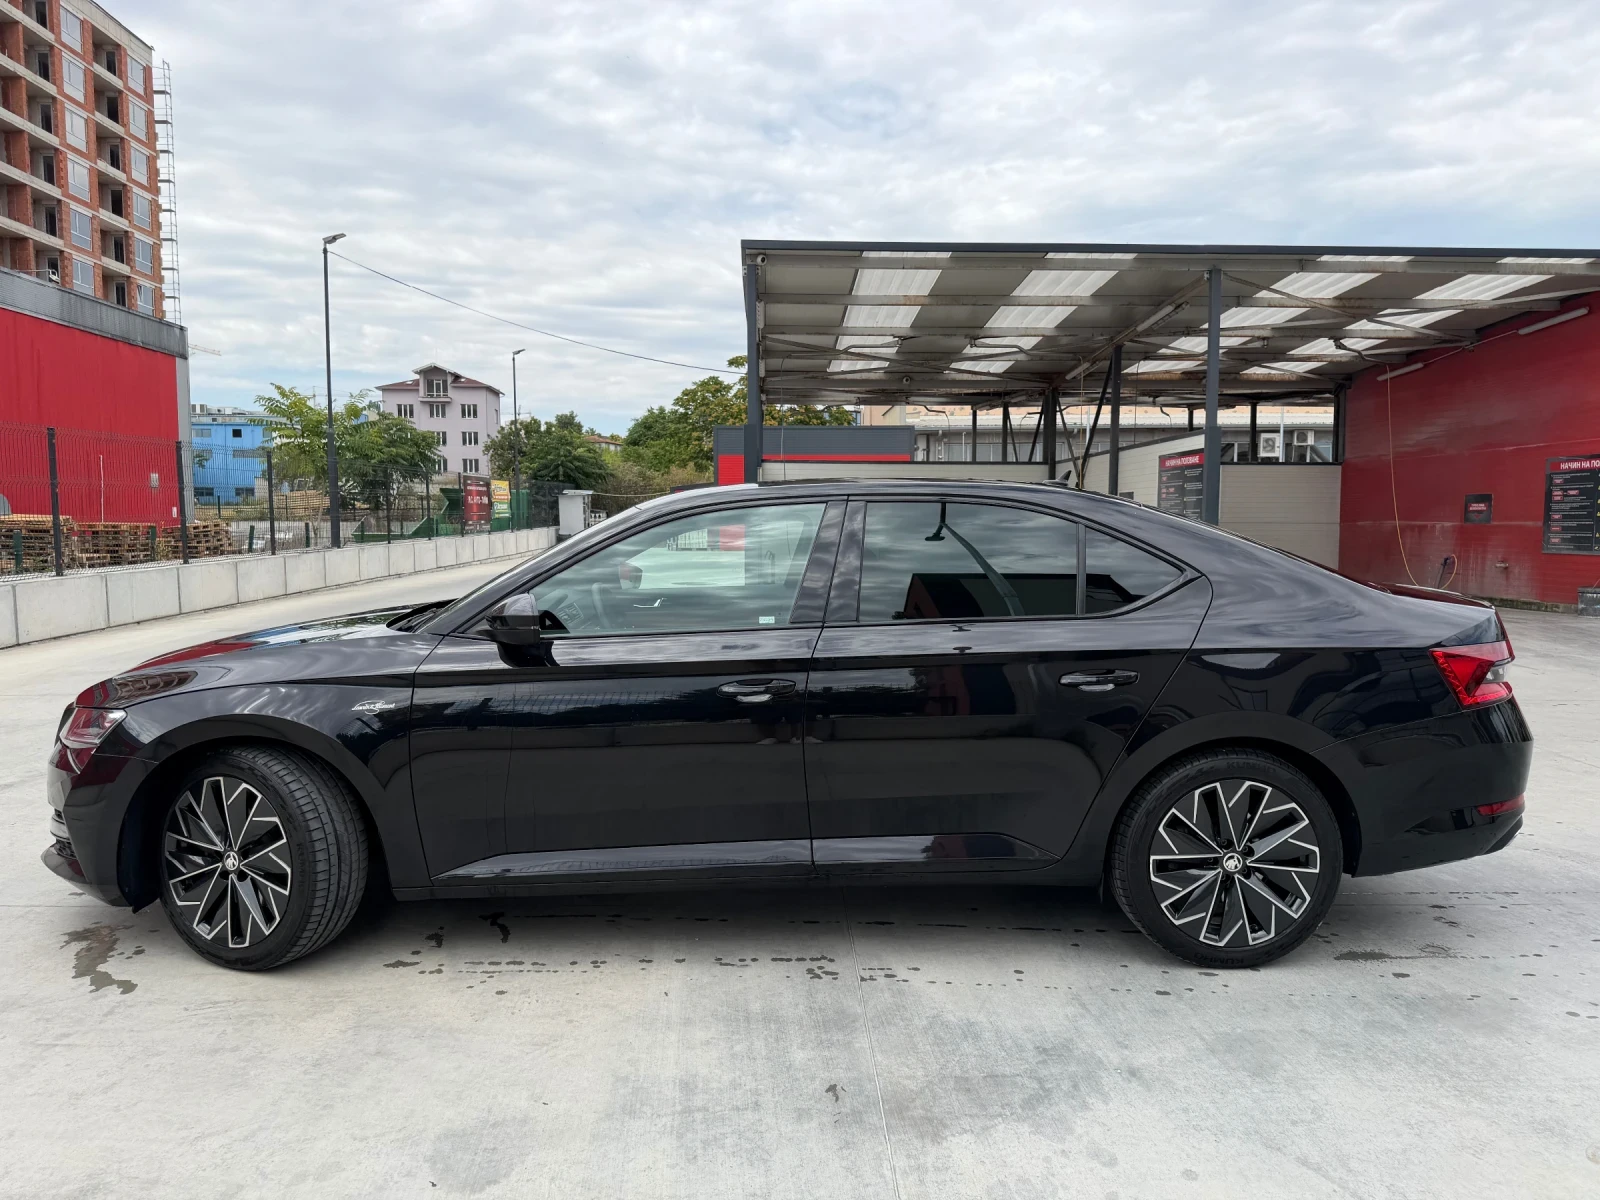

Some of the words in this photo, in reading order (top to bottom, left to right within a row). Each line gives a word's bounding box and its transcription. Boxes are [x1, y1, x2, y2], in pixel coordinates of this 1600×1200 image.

[1560, 461, 1581, 470] НАЧИН
[1581, 460, 1590, 469] НА
[1590, 459, 1600, 468] ПО
[1226, 761, 1276, 774] KUMHO
